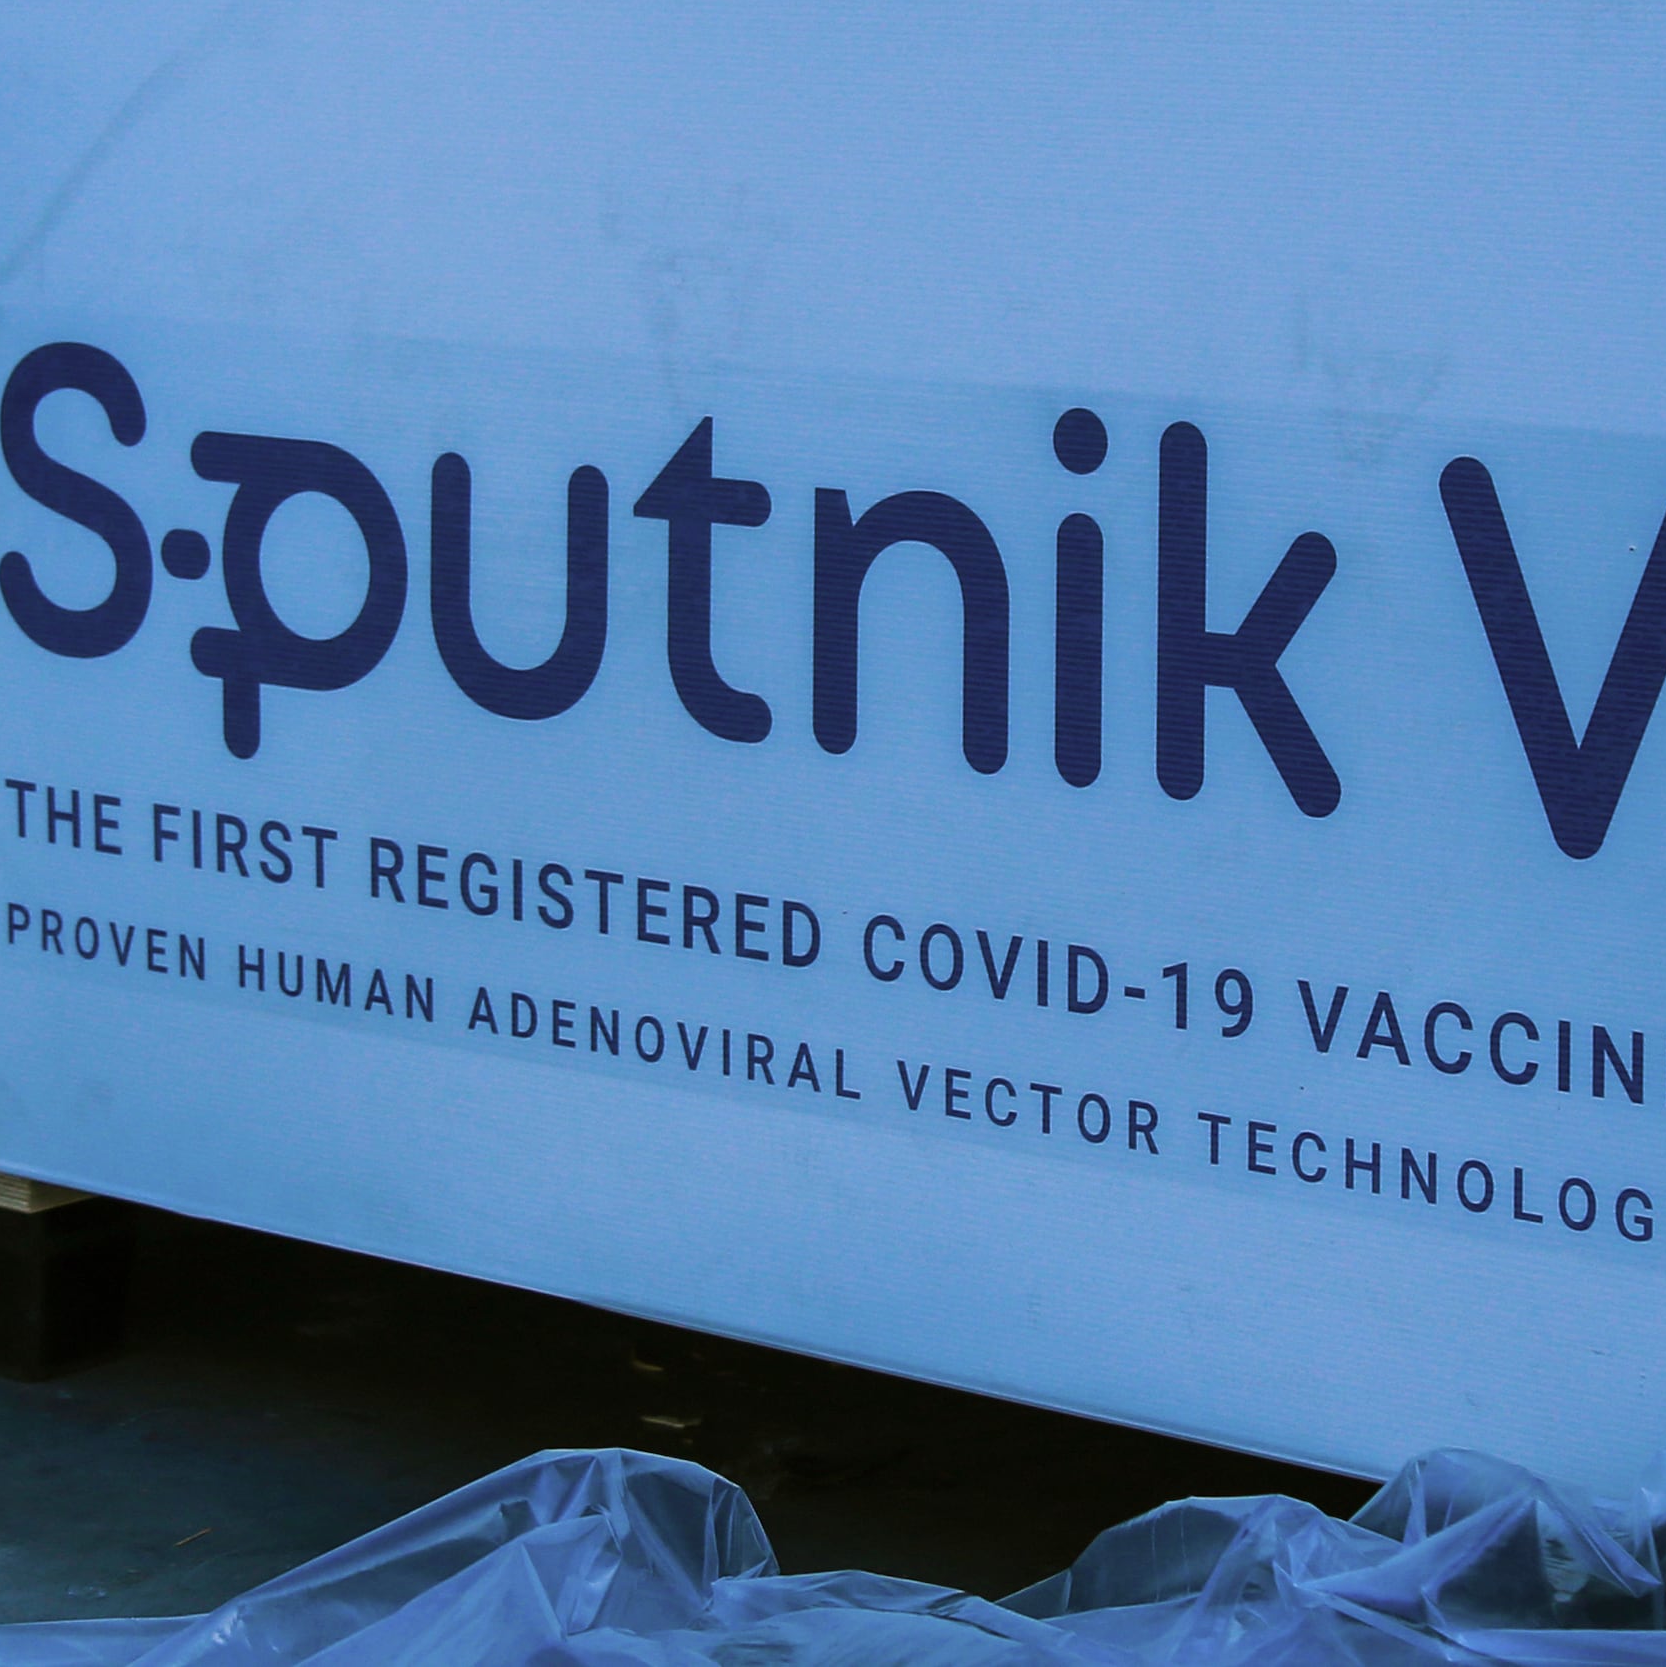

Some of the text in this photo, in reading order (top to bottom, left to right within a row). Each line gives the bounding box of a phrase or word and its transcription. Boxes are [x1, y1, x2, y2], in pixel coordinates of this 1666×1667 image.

[5, 779, 123, 854] THE
[153, 803, 338, 889] FIRST
[371, 836, 821, 968] REGISTERED
[863, 914, 1255, 1039] COVID-19
[7, 903, 206, 981] PROVEN
[238, 944, 435, 1023] HUMAN
[468, 986, 863, 1100] ADENOVIRAL
[897, 1059, 1160, 1155] VECTOR
